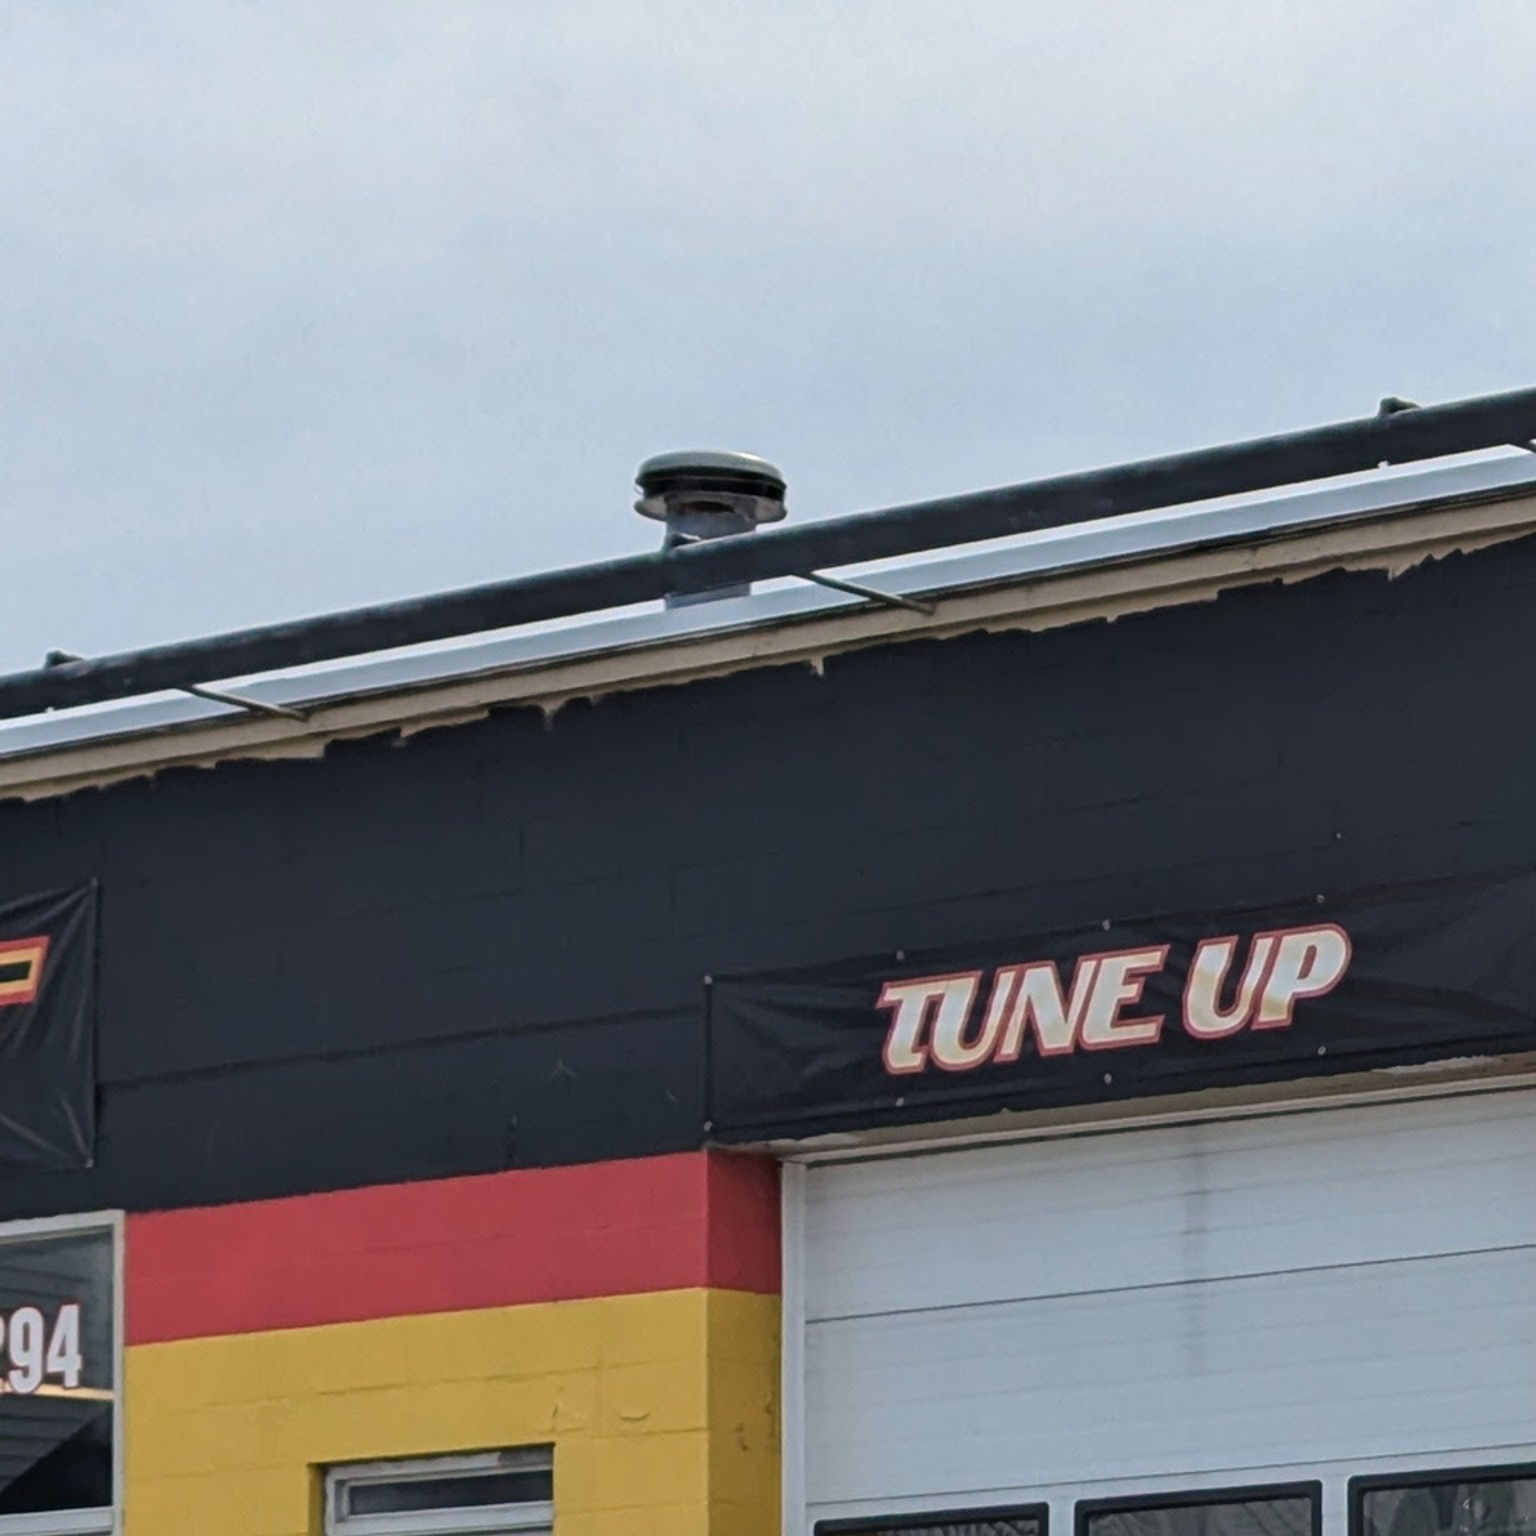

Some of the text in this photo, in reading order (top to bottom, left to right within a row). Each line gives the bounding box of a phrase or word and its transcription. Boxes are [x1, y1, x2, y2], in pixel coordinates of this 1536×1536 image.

[876, 923, 1352, 1075] TUNE UP
[0, 1304, 83, 1394] 94
